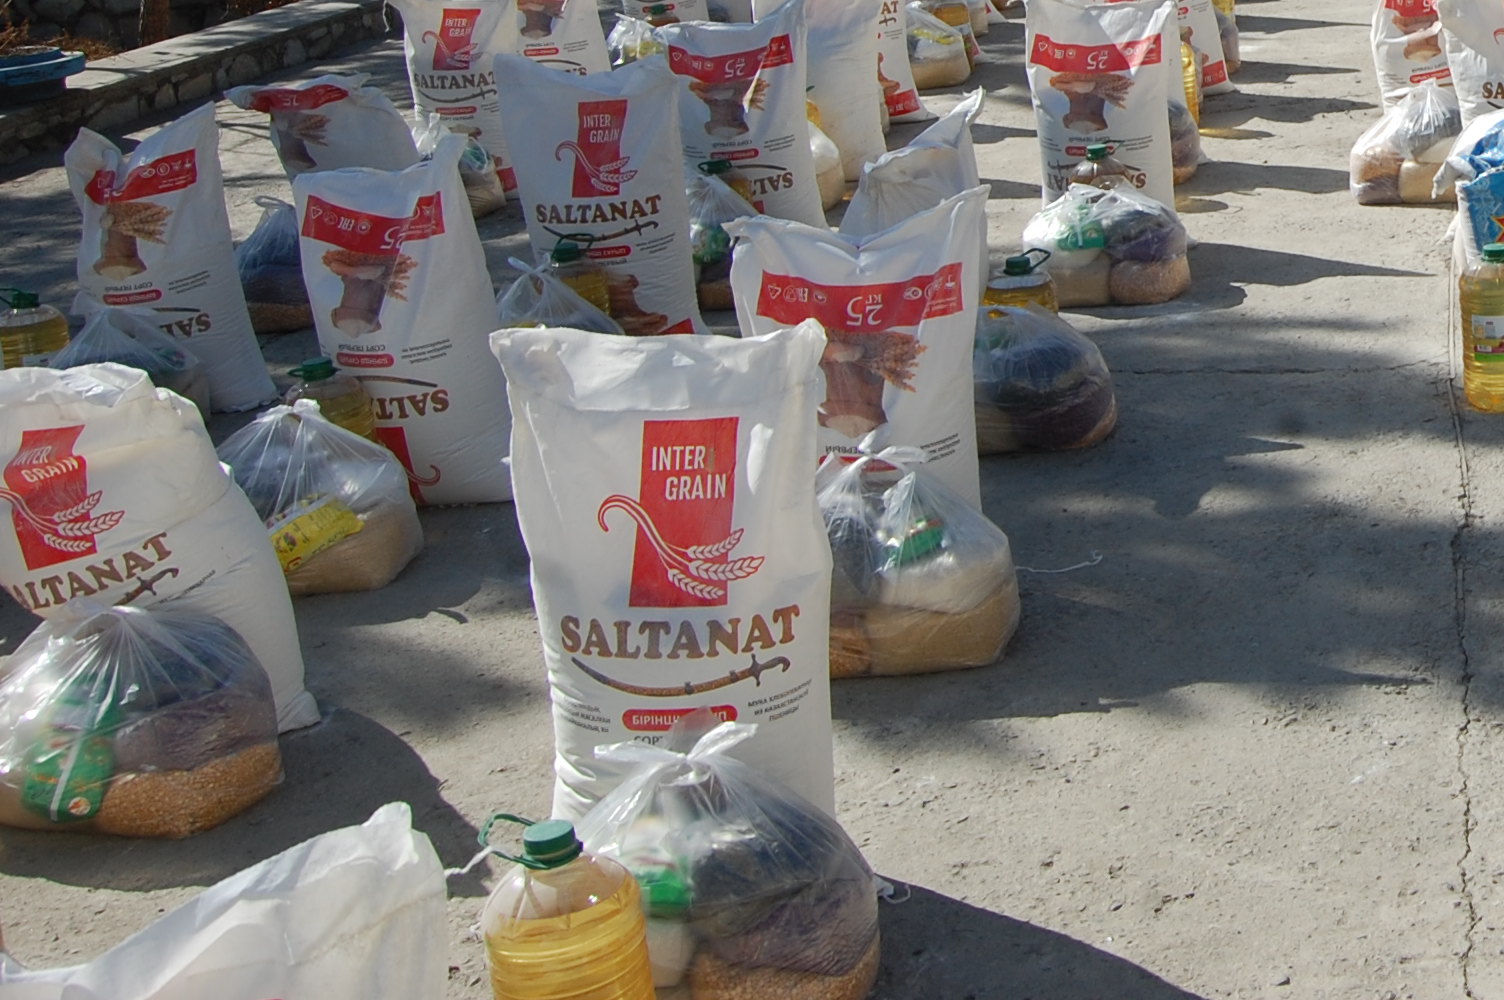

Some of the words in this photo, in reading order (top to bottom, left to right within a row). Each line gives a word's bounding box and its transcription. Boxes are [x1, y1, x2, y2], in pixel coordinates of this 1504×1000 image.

[725, 60, 745, 77] 25
[1087, 51, 1107, 70] 25
[583, 114, 611, 129] INTER
[589, 129, 620, 144] GRAIN
[536, 194, 662, 224] SALTANAT
[846, 297, 883, 326] 25
[866, 294, 882, 304] КГ
[375, 387, 449, 420] SALT
[12, 444, 52, 467] INTER
[652, 446, 707, 472] INTER
[21, 457, 79, 485] GRAIN
[665, 475, 727, 500] GRAIN
[561, 603, 801, 660] SALTANAT
[632, 714, 680, 726] БІРІНШ
